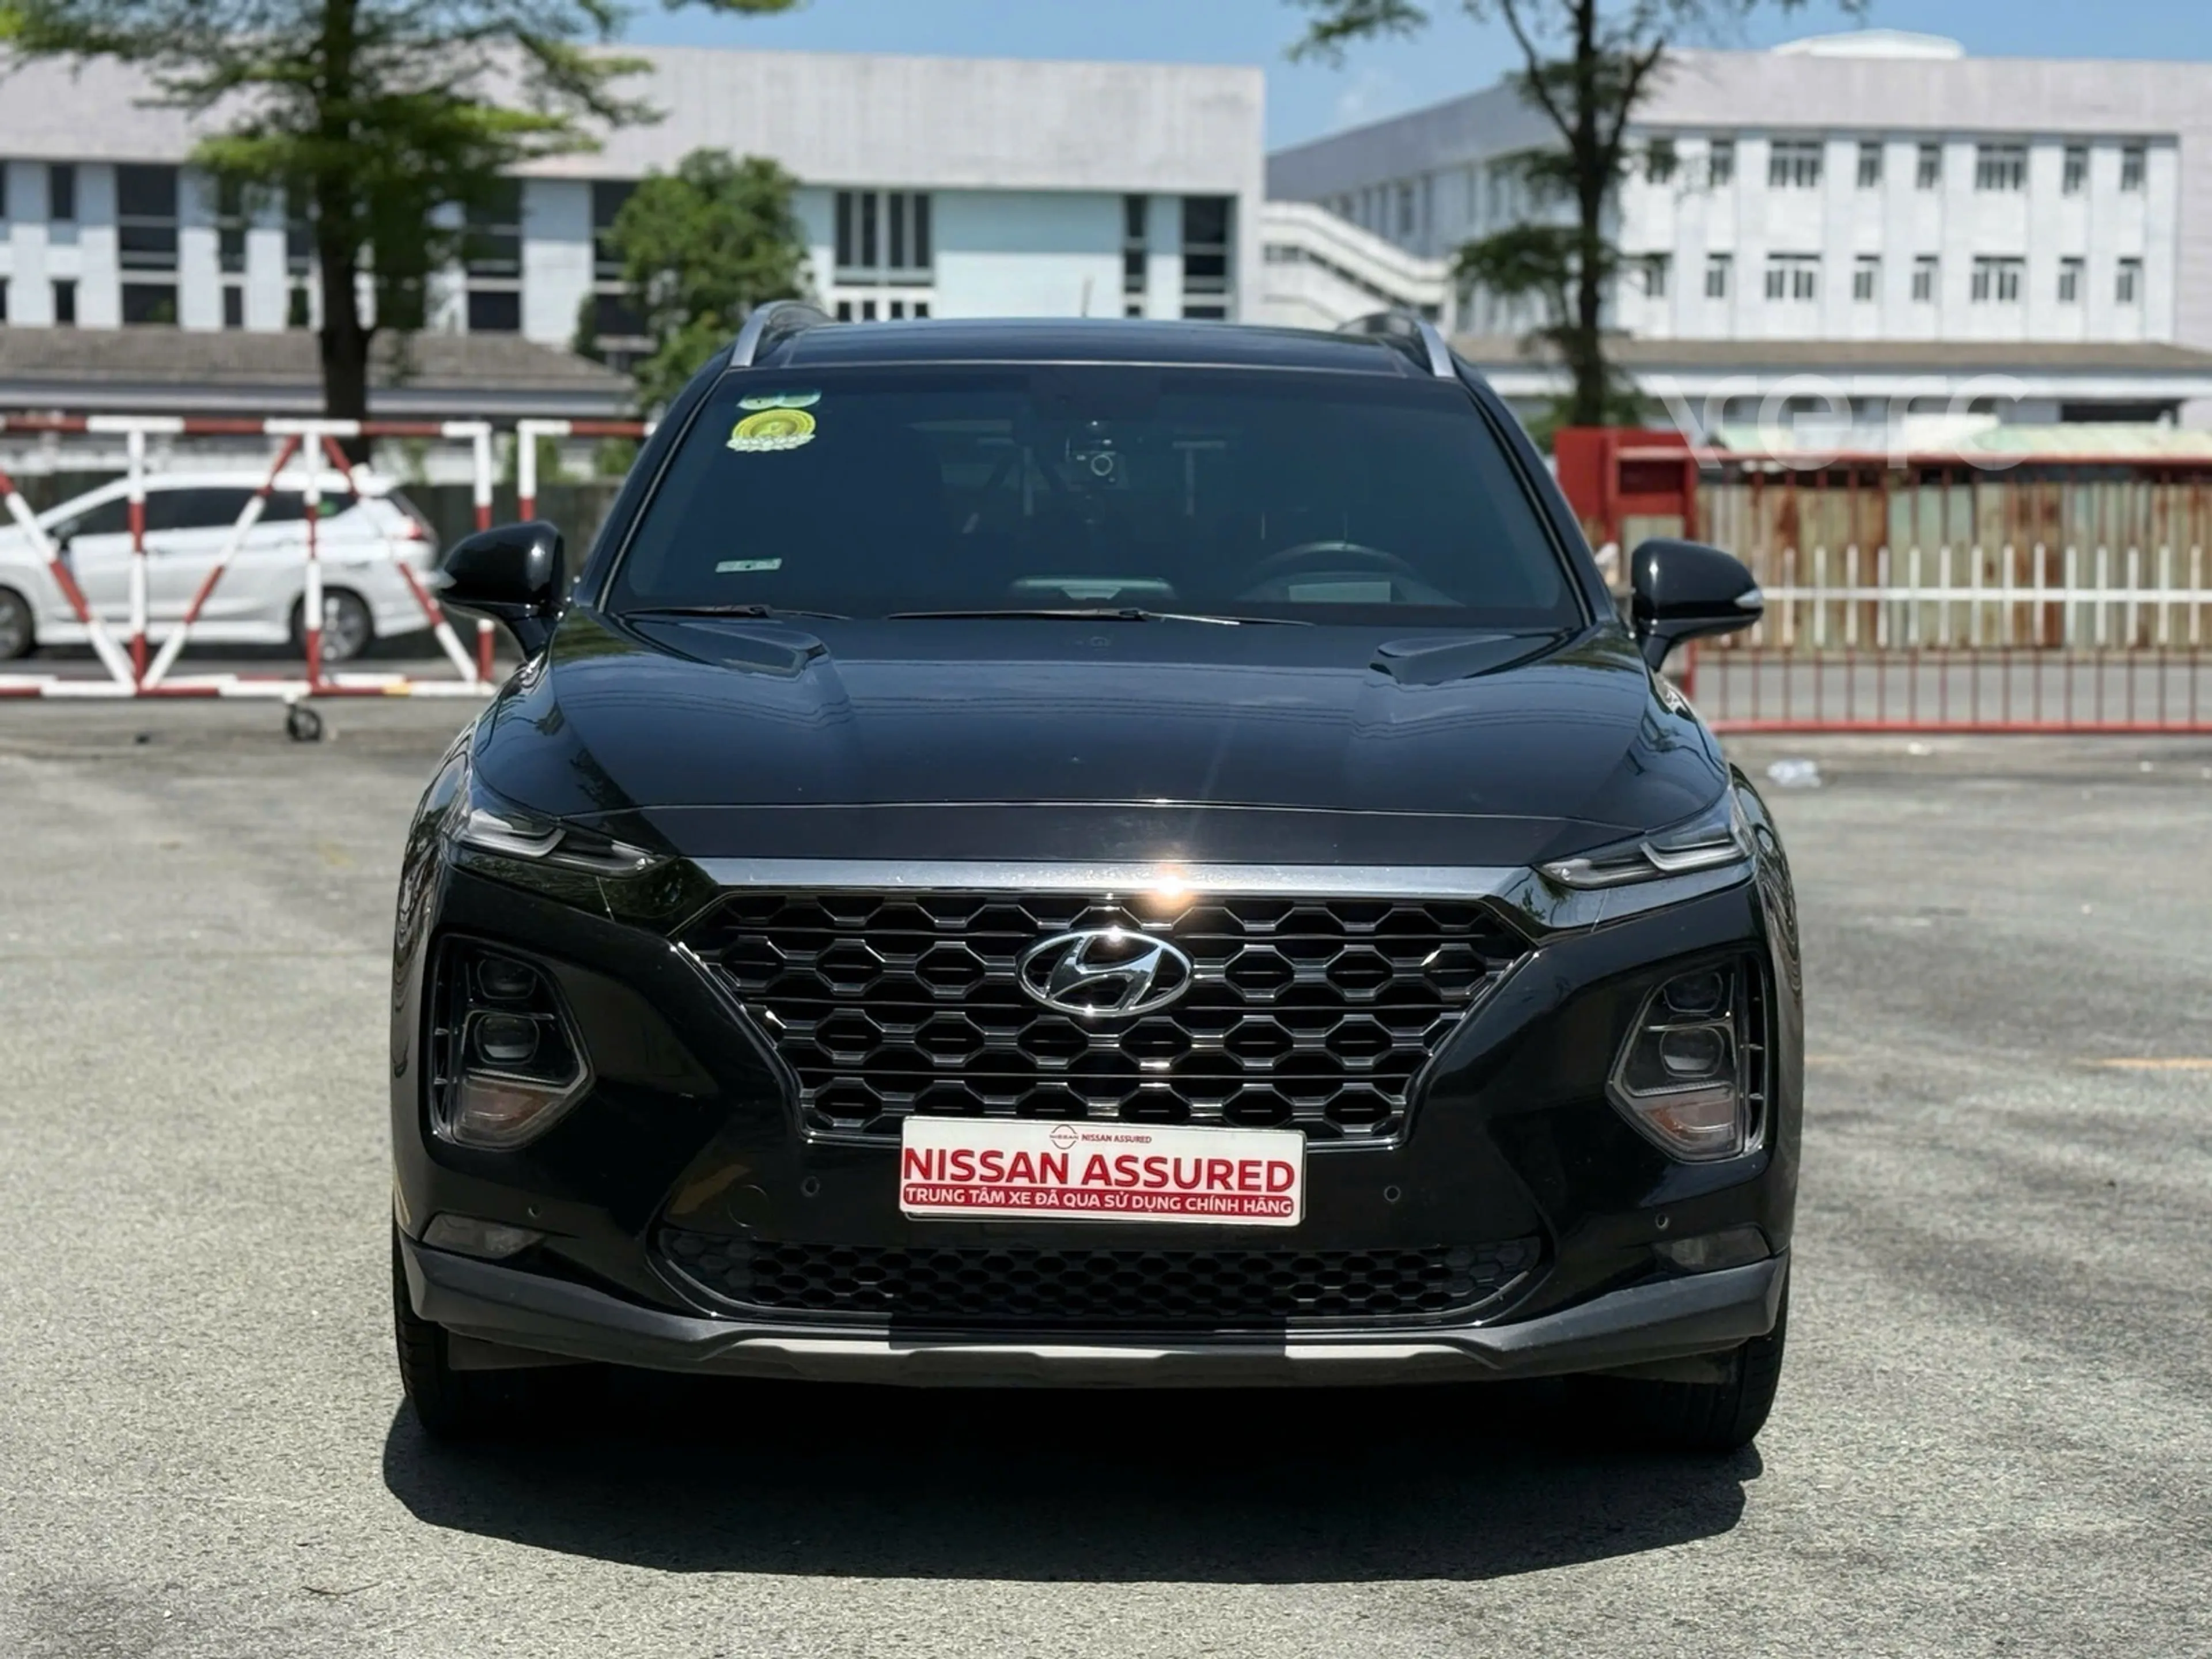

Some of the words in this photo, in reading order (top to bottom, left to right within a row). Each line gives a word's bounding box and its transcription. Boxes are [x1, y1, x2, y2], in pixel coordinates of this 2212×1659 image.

[1081, 1133, 1112, 1142] NISSAN
[1113, 1134, 1152, 1144] ASSURED
[903, 1147, 1069, 1185] NISSAN
[1081, 1153, 1295, 1193] ASSURED
[905, 1187, 965, 1203] TRUNG
[969, 1187, 1005, 1205] TÂM
[1009, 1191, 1031, 1205] XE
[1035, 1189, 1060, 1206] ĐÃ
[1063, 1192, 1101, 1208] QUA
[1104, 1191, 1130, 1208] SỬ
[1132, 1195, 1181, 1213] DỤNG
[1185, 1194, 1239, 1212] CHÍNH
